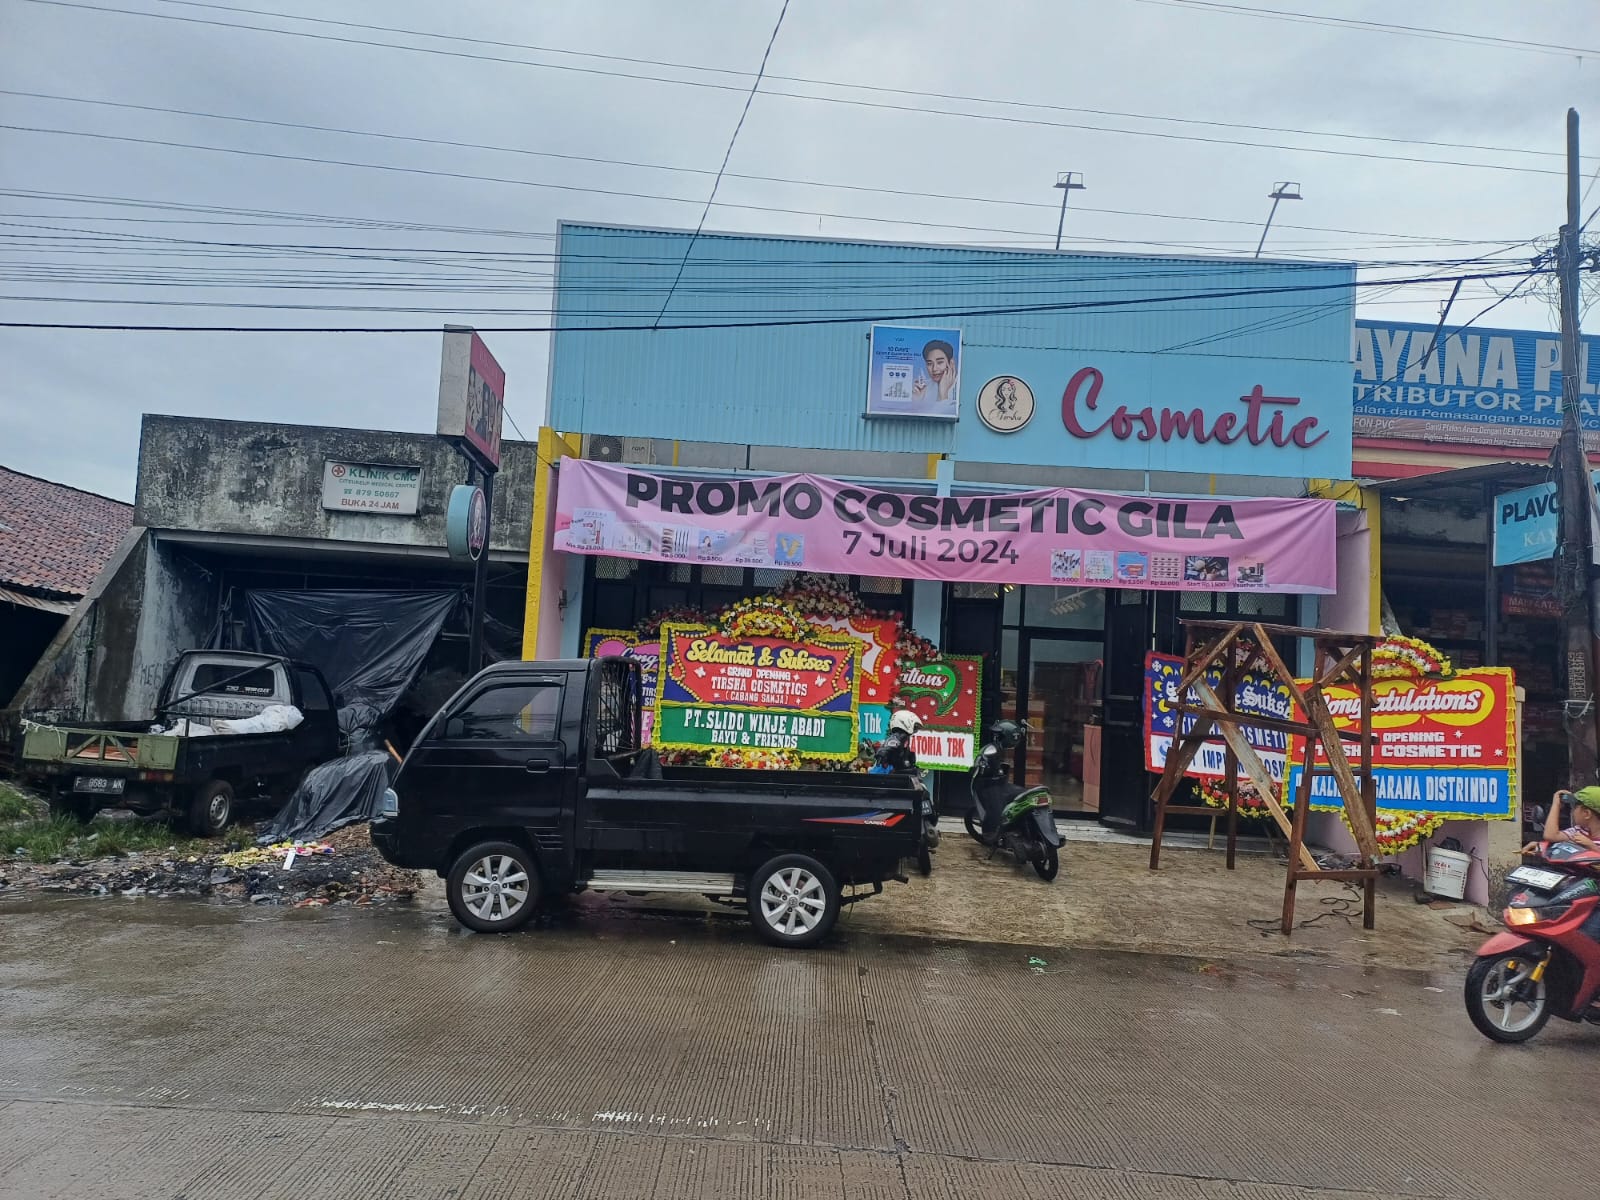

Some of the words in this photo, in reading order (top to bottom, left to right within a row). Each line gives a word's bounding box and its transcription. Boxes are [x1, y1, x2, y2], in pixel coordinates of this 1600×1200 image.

[1534, 339, 1600, 395] PL
[1061, 367, 1329, 448] Cosmetic
[1390, 407, 1418, 417] dan
[1422, 409, 1517, 423] Pemasangan
[1534, 395, 1600, 416] PLA
[349, 468, 392, 480] KLINIK
[393, 472, 417, 481] CMC
[341, 498, 367, 507] BUKA
[368, 500, 379, 508] 24
[380, 501, 400, 510] JAM
[625, 474, 823, 520] PROMO
[833, 489, 1107, 536] COSMETIC
[1117, 501, 1245, 540] GILA
[842, 530, 862, 555] 7
[869, 532, 927, 561] Juli
[937, 538, 1019, 565] 2024
[686, 639, 755, 666] Selamat
[757, 646, 775, 667] &
[776, 648, 833, 672] Sukses
[727, 666, 753, 678] GRAND
[756, 669, 791, 681] OPENING
[711, 676, 747, 691] TIRSHA
[750, 679, 808, 696] COSMETICS
[749, 713, 787, 734] WINJE
[791, 716, 826, 738] ABADI
[863, 712, 882, 734] Tbk
[711, 730, 737, 745] BAYU
[741, 732, 751, 745] &
[754, 733, 798, 749] FRIENDS
[909, 735, 942, 757] ATORIA
[947, 737, 965, 759] TBK
[1383, 732, 1445, 743] OPENING
[1381, 744, 1482, 758] COSMETIC
[1426, 776, 1498, 804] DISTRINDO
